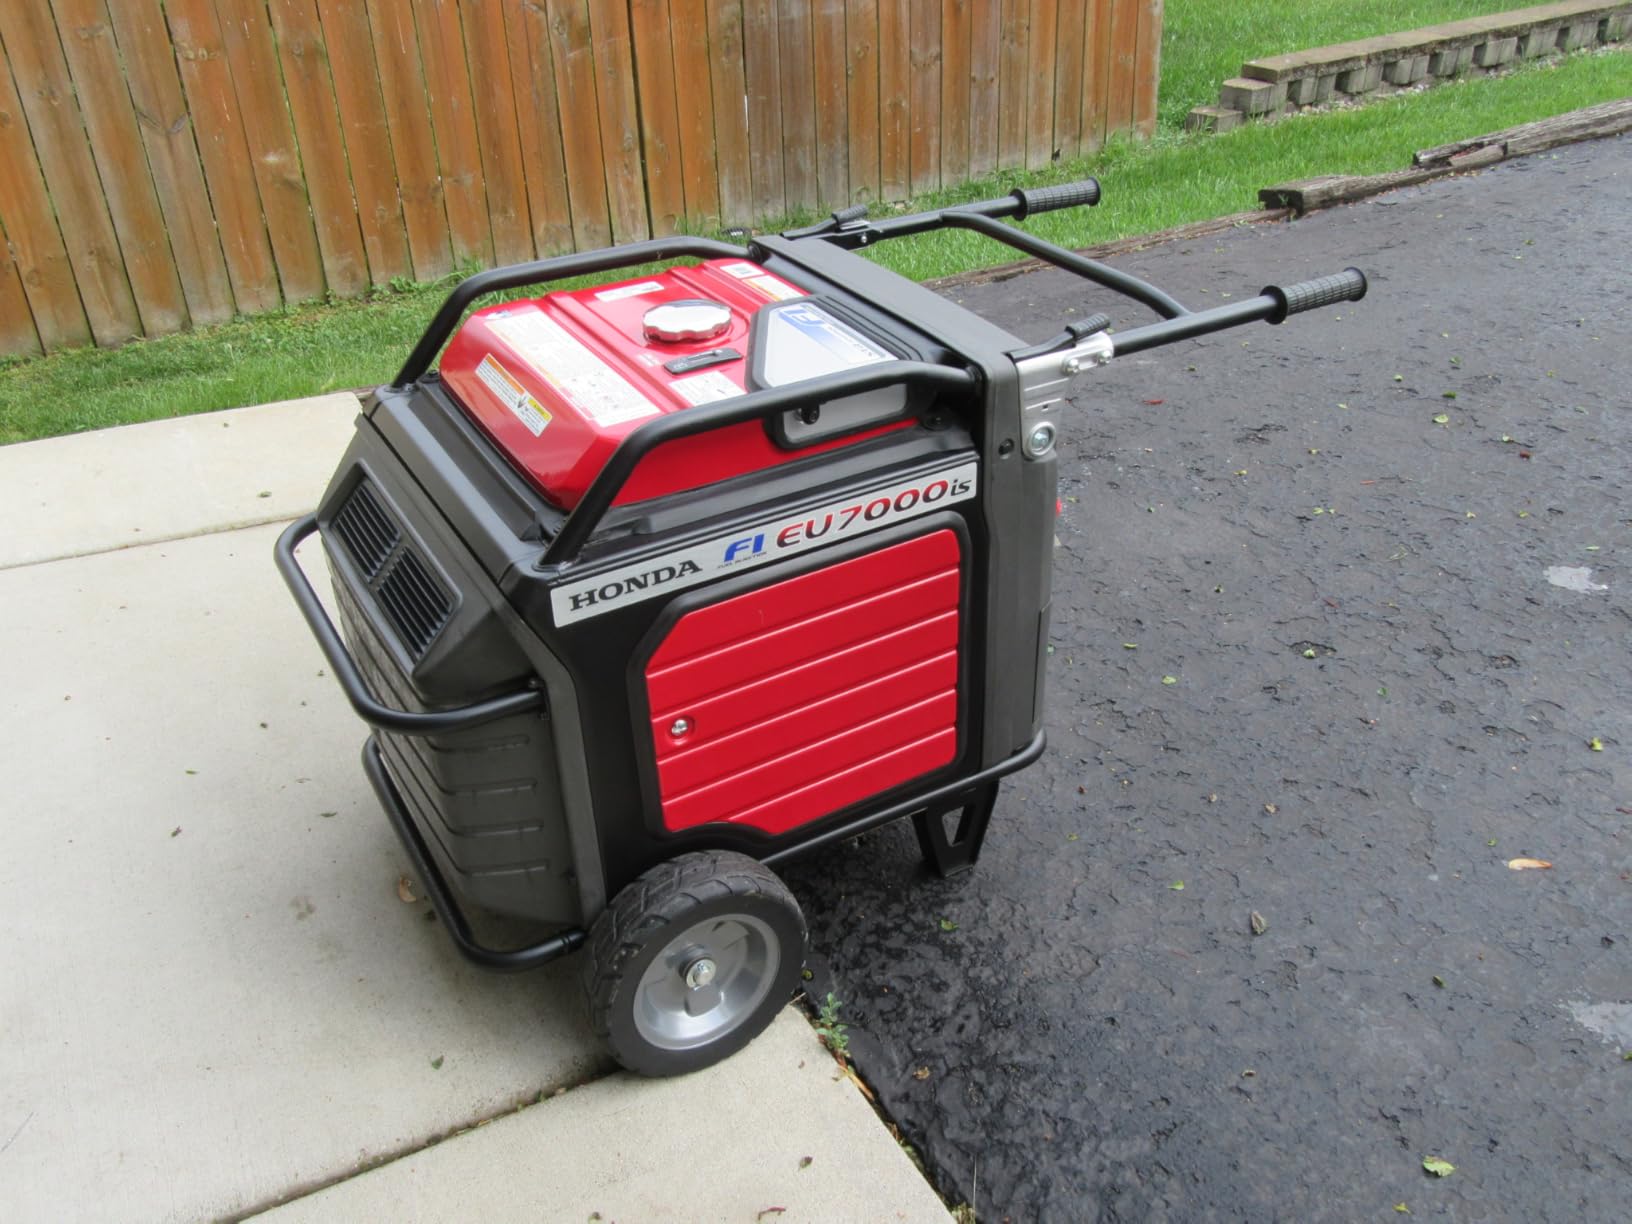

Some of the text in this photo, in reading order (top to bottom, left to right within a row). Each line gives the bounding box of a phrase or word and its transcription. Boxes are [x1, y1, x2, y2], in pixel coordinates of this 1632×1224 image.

[569, 479, 972, 612] HONDA FI EU7000is
